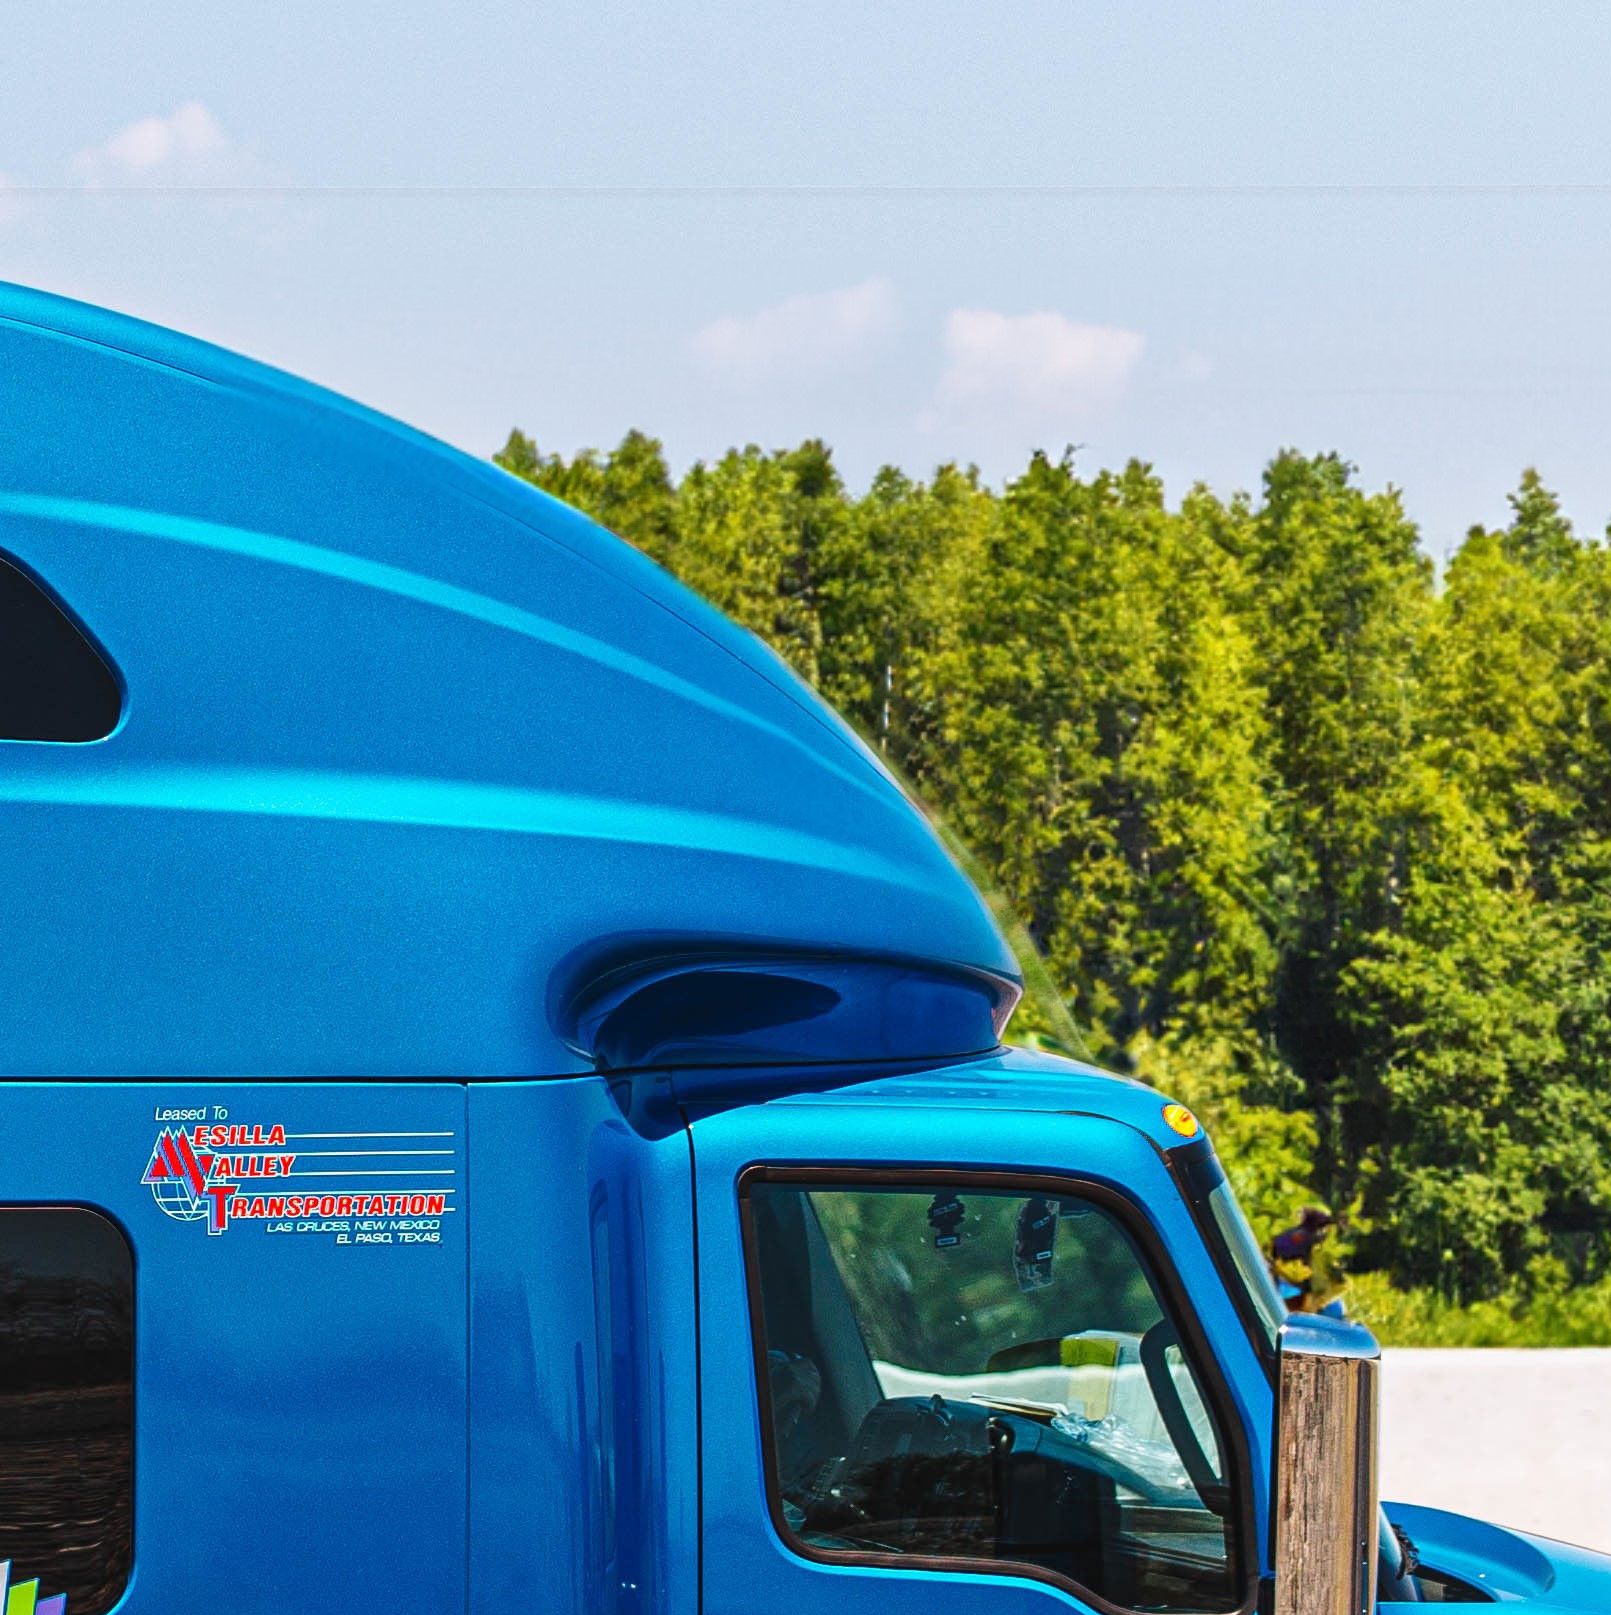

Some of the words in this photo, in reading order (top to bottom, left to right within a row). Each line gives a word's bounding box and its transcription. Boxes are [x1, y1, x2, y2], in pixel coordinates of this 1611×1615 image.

[155, 1107, 206, 1121] Leased
[213, 1105, 229, 1120] To
[266, 1222, 294, 1233] LAS
[296, 1222, 351, 1233] CRUCES,
[354, 1221, 388, 1231] NEW
[389, 1220, 440, 1230] MEXICO
[336, 1234, 352, 1244] EL
[355, 1233, 393, 1244] PASO,
[397, 1233, 441, 1243] TEXAS
